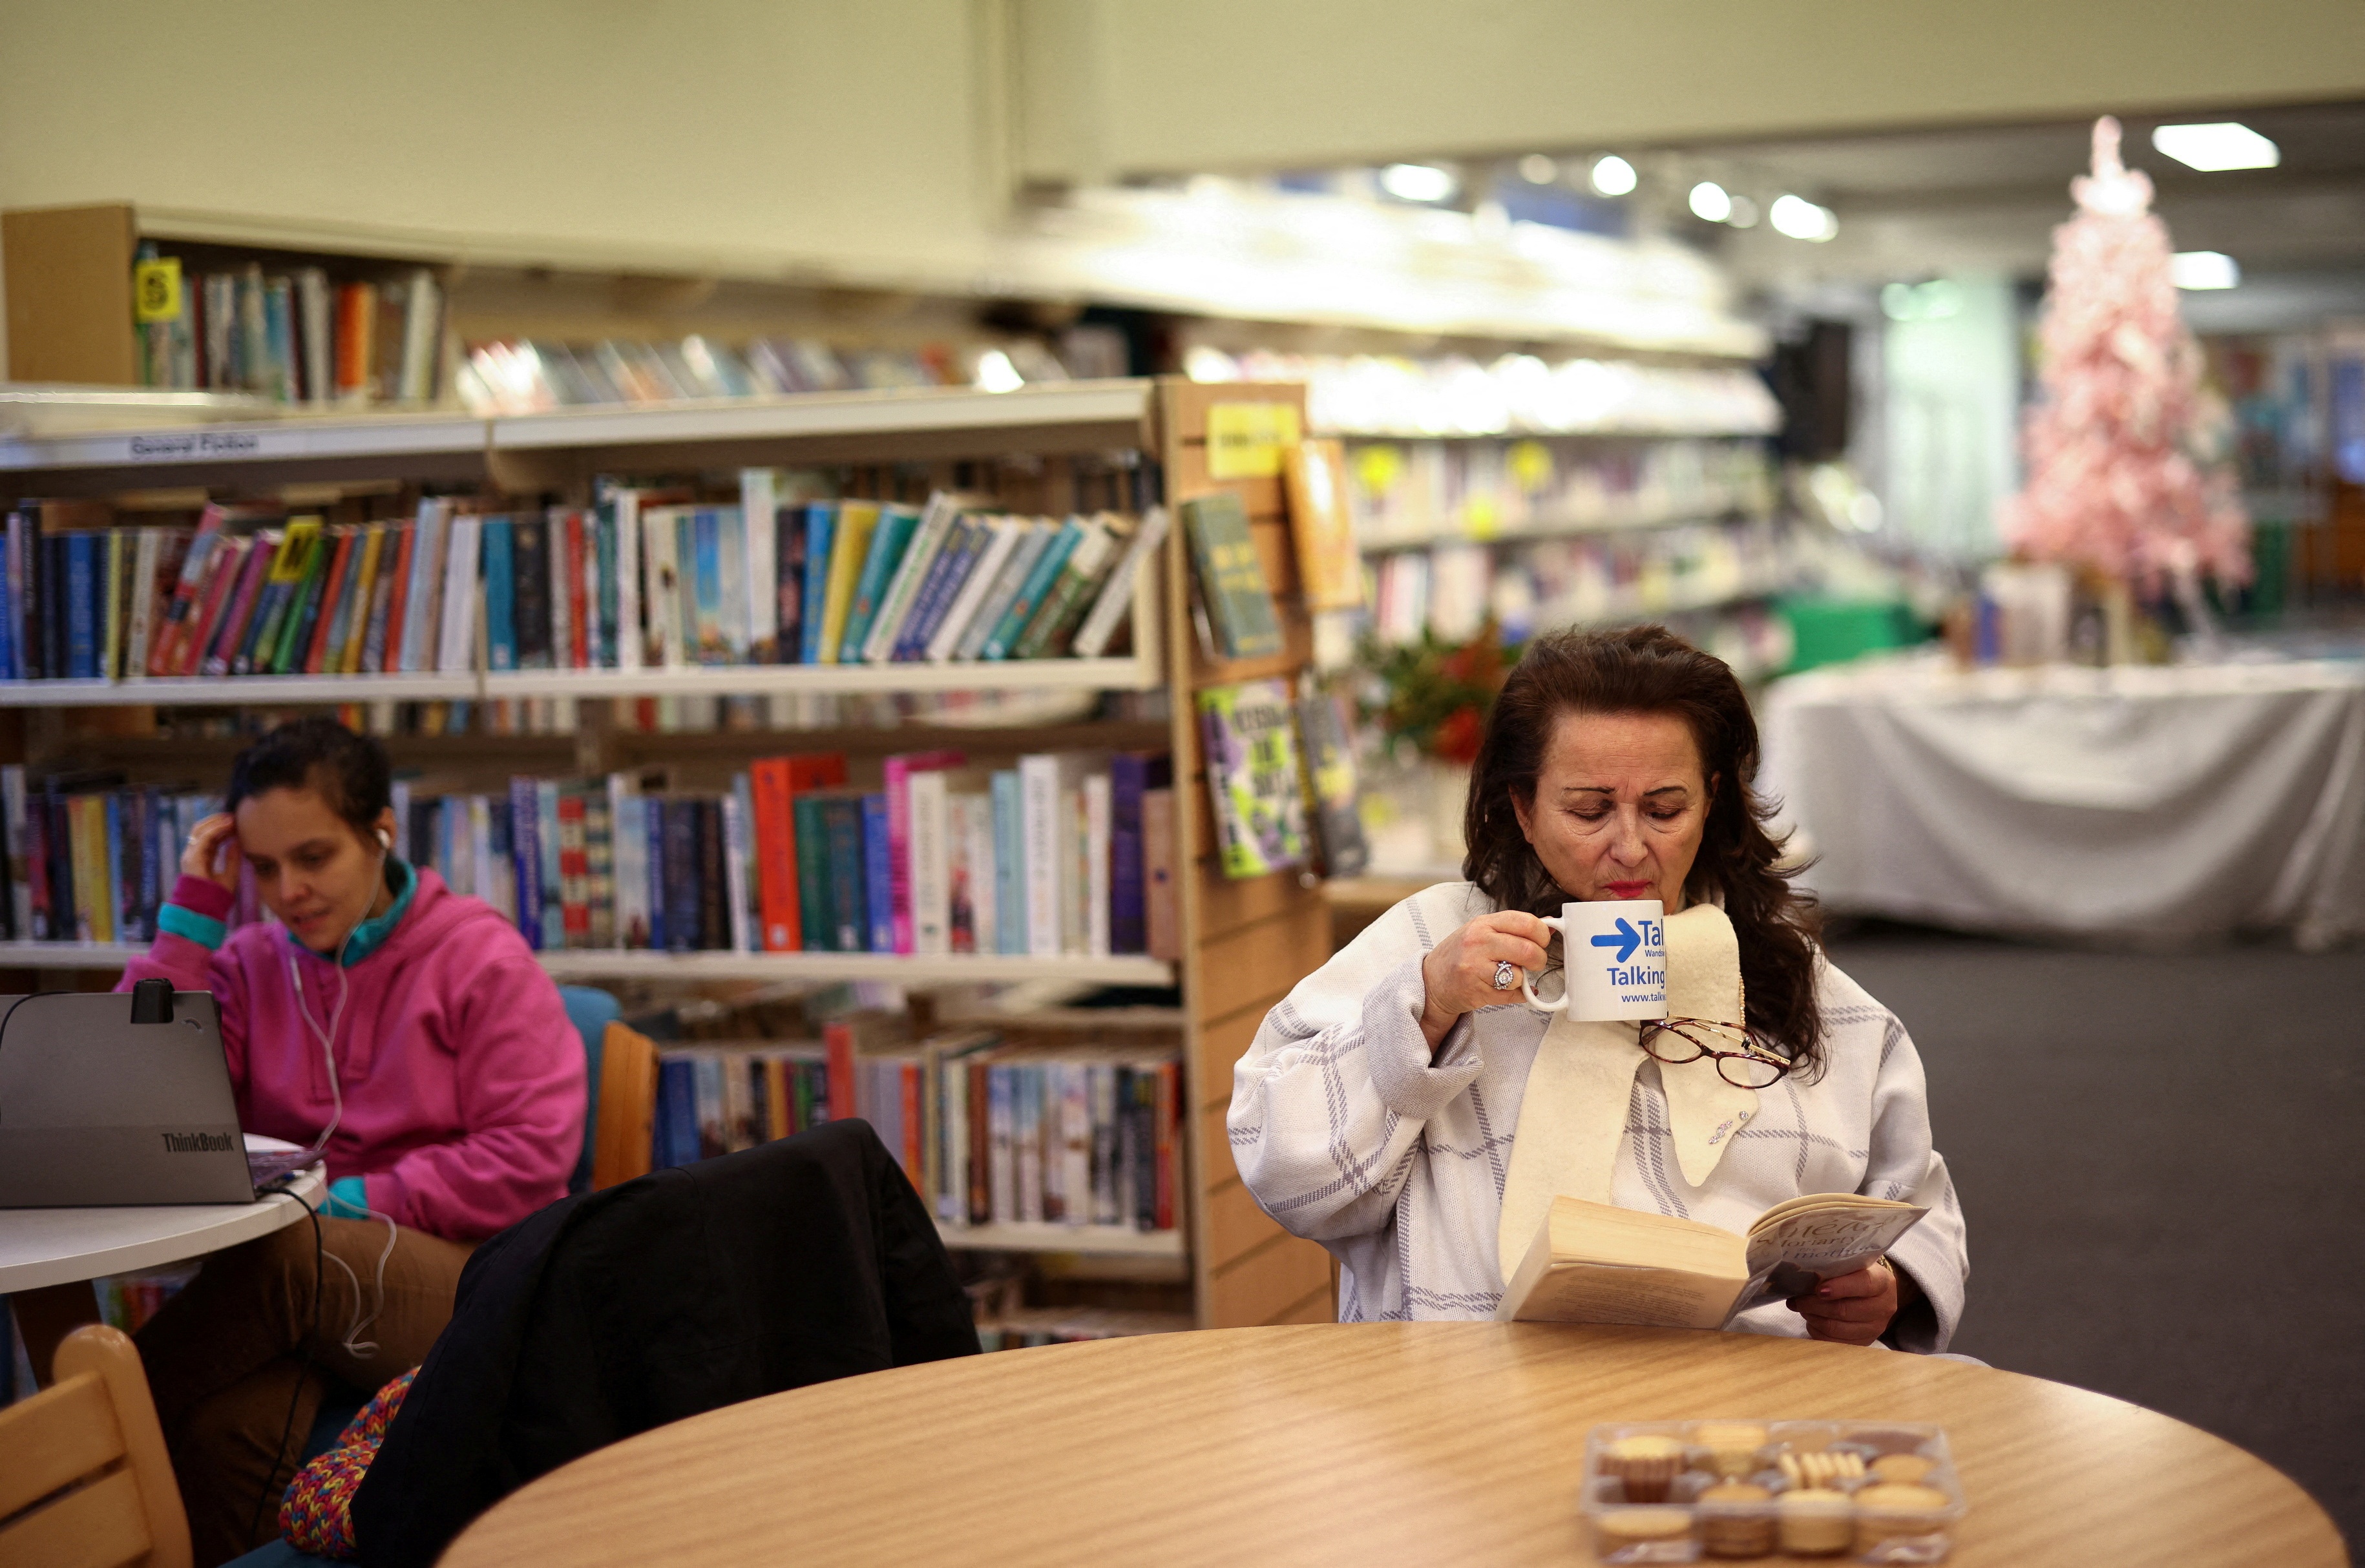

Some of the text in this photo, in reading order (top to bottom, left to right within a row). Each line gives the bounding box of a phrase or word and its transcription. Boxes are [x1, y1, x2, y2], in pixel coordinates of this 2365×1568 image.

[1606, 966, 1665, 988] Talking
[1621, 992, 1666, 1002] www.talkw
[162, 1132, 233, 1152] ThinkBook
